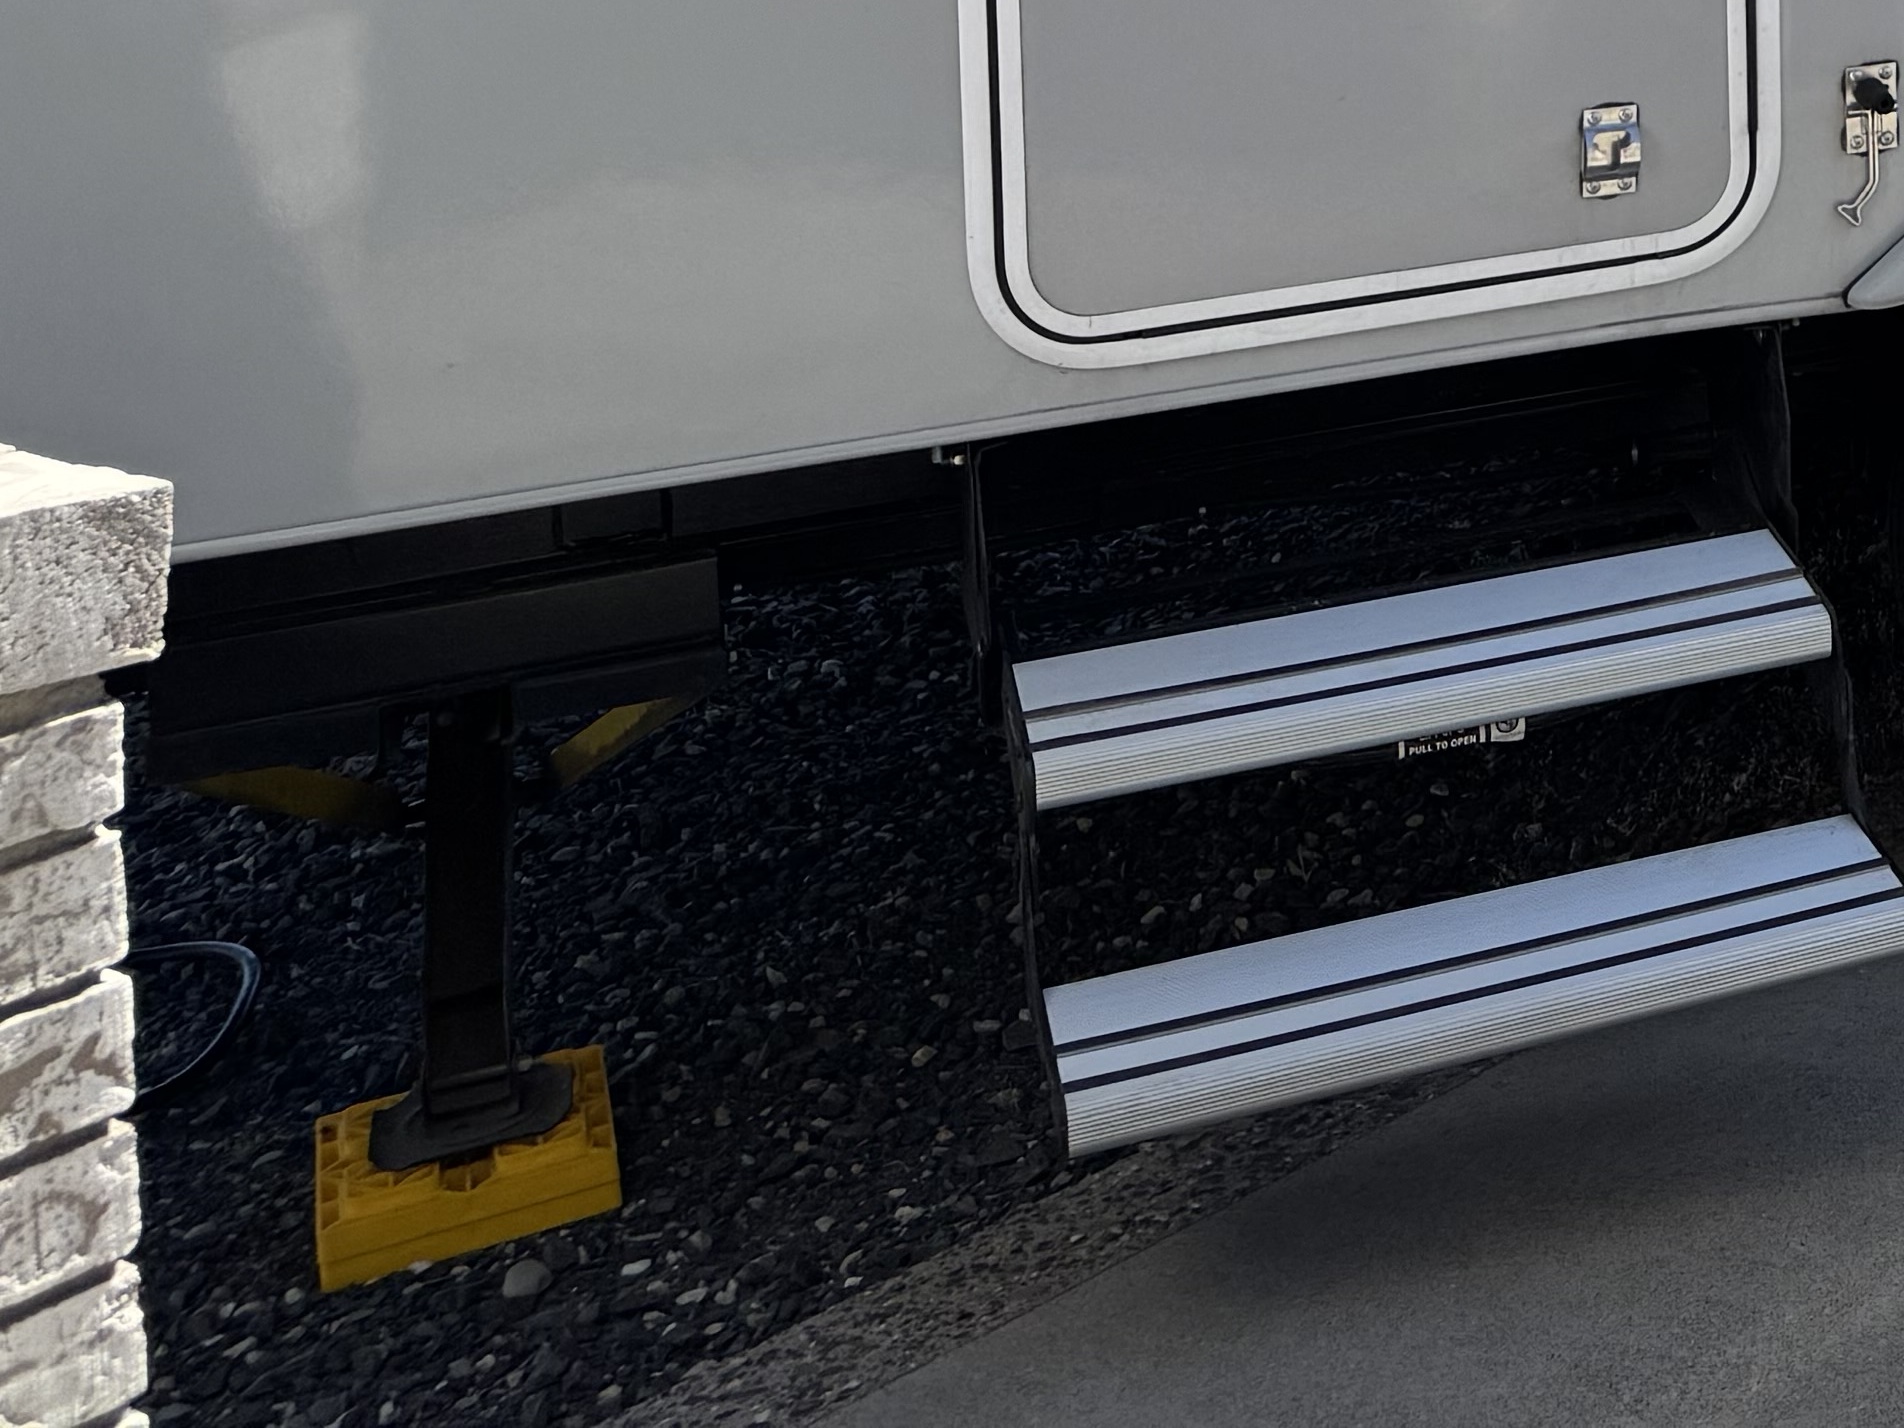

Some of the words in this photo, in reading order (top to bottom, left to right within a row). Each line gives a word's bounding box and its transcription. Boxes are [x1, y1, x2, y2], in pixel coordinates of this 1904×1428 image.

[1408, 744, 1433, 756] PULL
[1435, 740, 1449, 751] TO
[1450, 734, 1477, 748] OPEN
